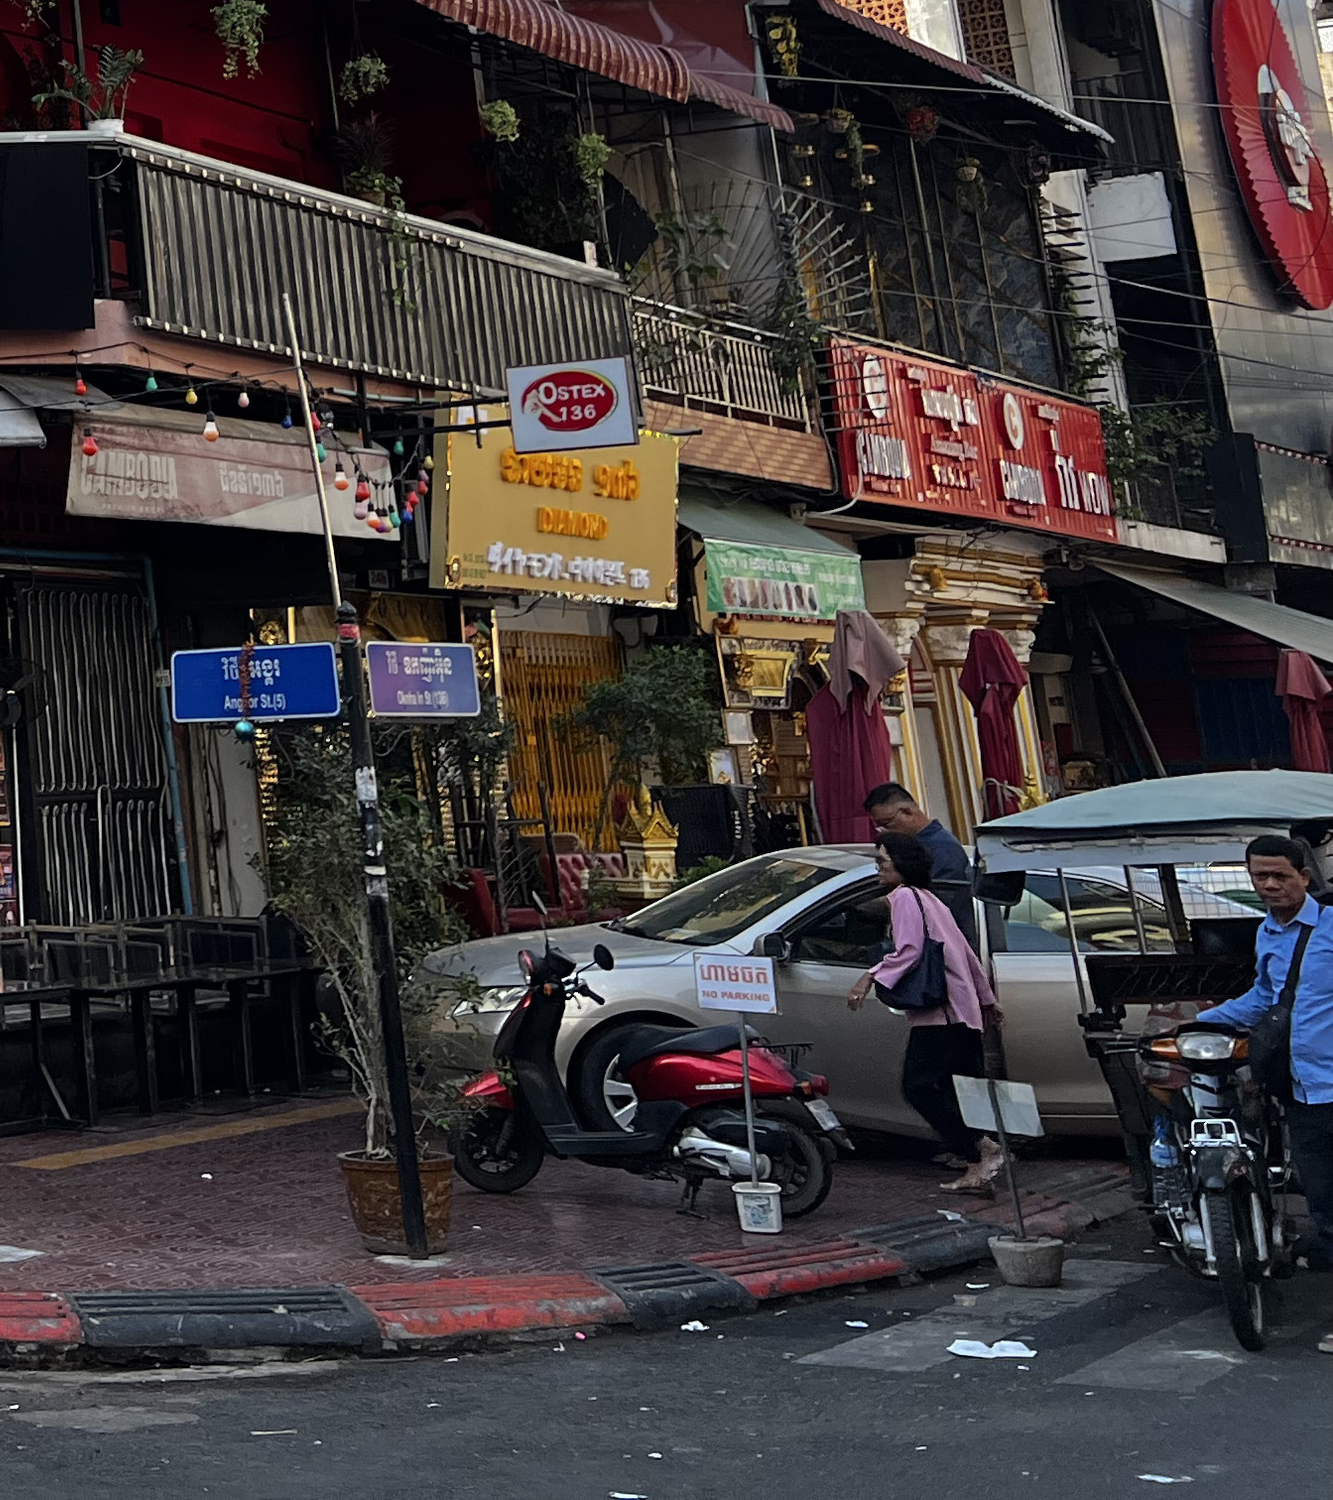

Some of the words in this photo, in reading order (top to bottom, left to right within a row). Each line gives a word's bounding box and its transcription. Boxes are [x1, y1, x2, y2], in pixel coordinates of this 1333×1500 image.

[538, 381, 605, 405] OSTEX
[559, 404, 596, 421] 136
[224, 695, 258, 713] Angor
[702, 990, 717, 998] NO
[721, 991, 770, 1002] PARKING
